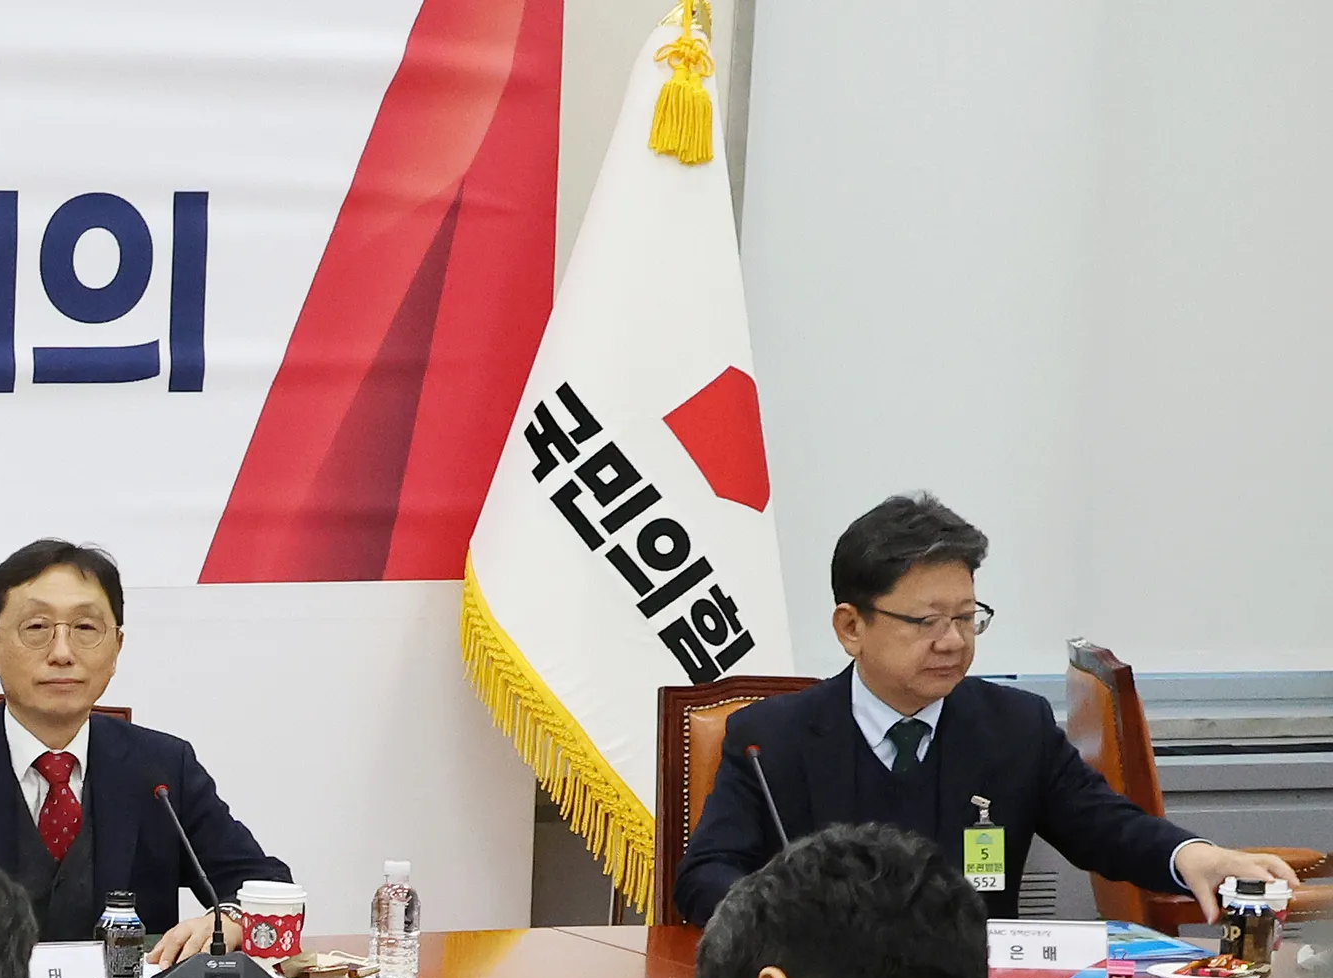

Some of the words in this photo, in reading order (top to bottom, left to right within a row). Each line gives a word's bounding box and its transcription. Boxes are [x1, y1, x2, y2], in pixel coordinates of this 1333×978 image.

[523, 381, 756, 685] 국민의힘
[980, 848, 989, 861] 5
[973, 876, 997, 889] 552
